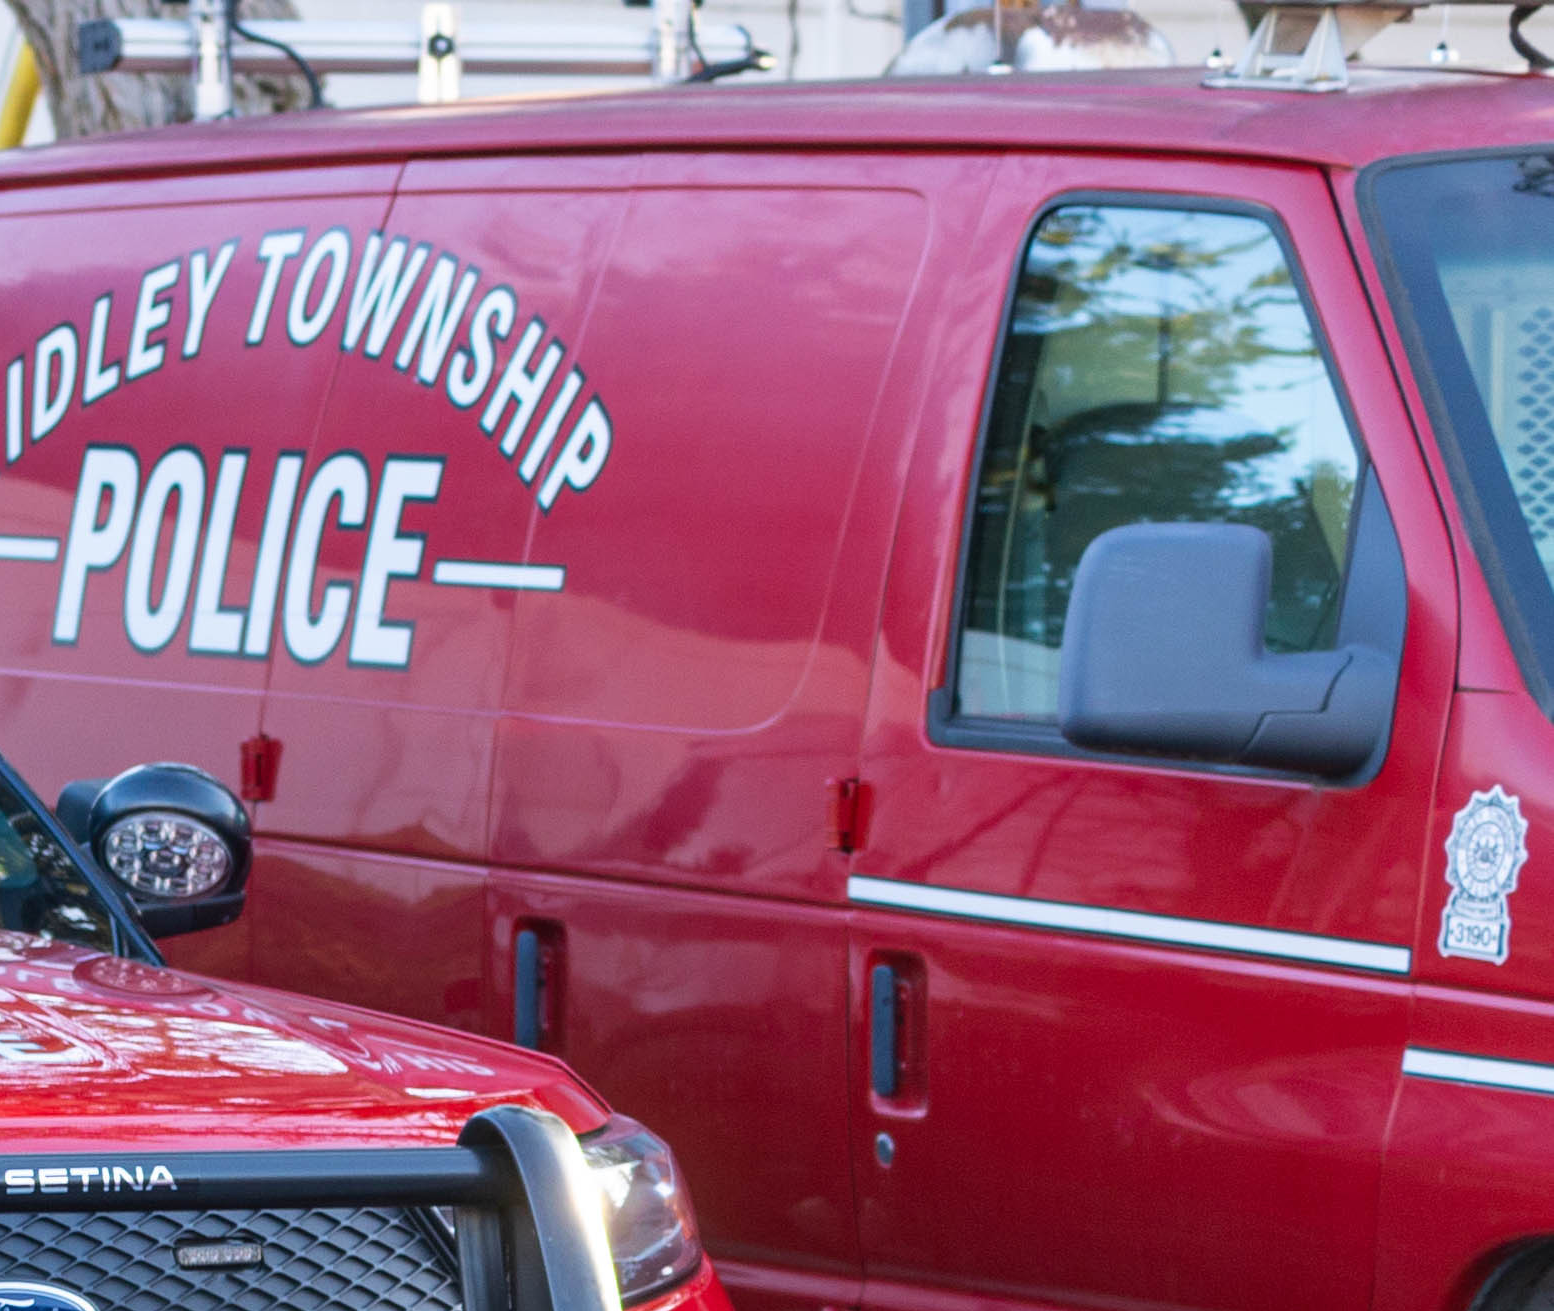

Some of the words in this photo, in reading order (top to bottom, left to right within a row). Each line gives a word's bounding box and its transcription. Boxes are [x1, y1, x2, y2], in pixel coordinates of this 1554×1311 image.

[244, 226, 614, 513] TOWNSHIP
[50, 441, 447, 670] POLICE
[1453, 924, 1493, 948] 3190
[4, 1165, 178, 1195] SETINA
